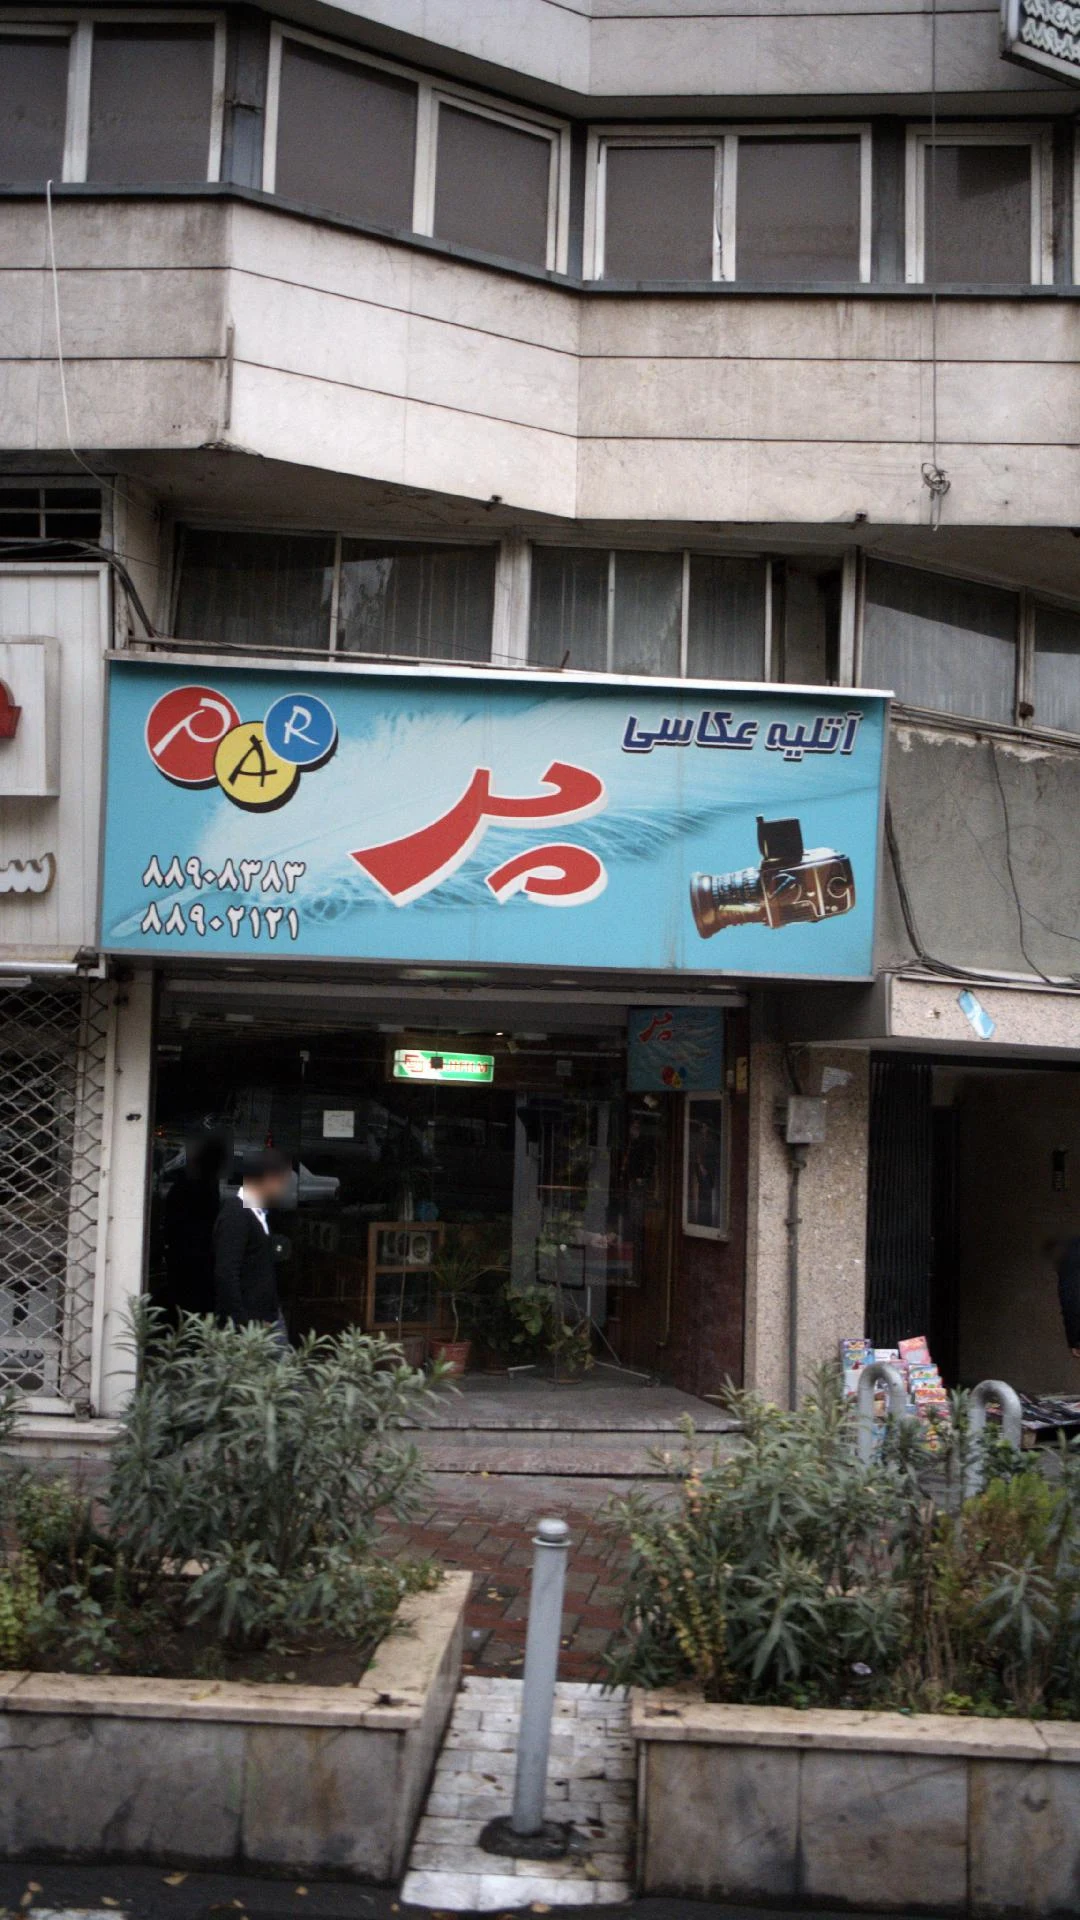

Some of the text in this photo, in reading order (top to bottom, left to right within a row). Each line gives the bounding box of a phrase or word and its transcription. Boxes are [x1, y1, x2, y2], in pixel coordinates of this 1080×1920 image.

[621, 710, 863, 761] آتلیه عکاسی
[142, 854, 306, 893] ۸۸۹۰۸۳۸۳
[141, 901, 299, 940] ۸۸۹۰۲۱۲۱
